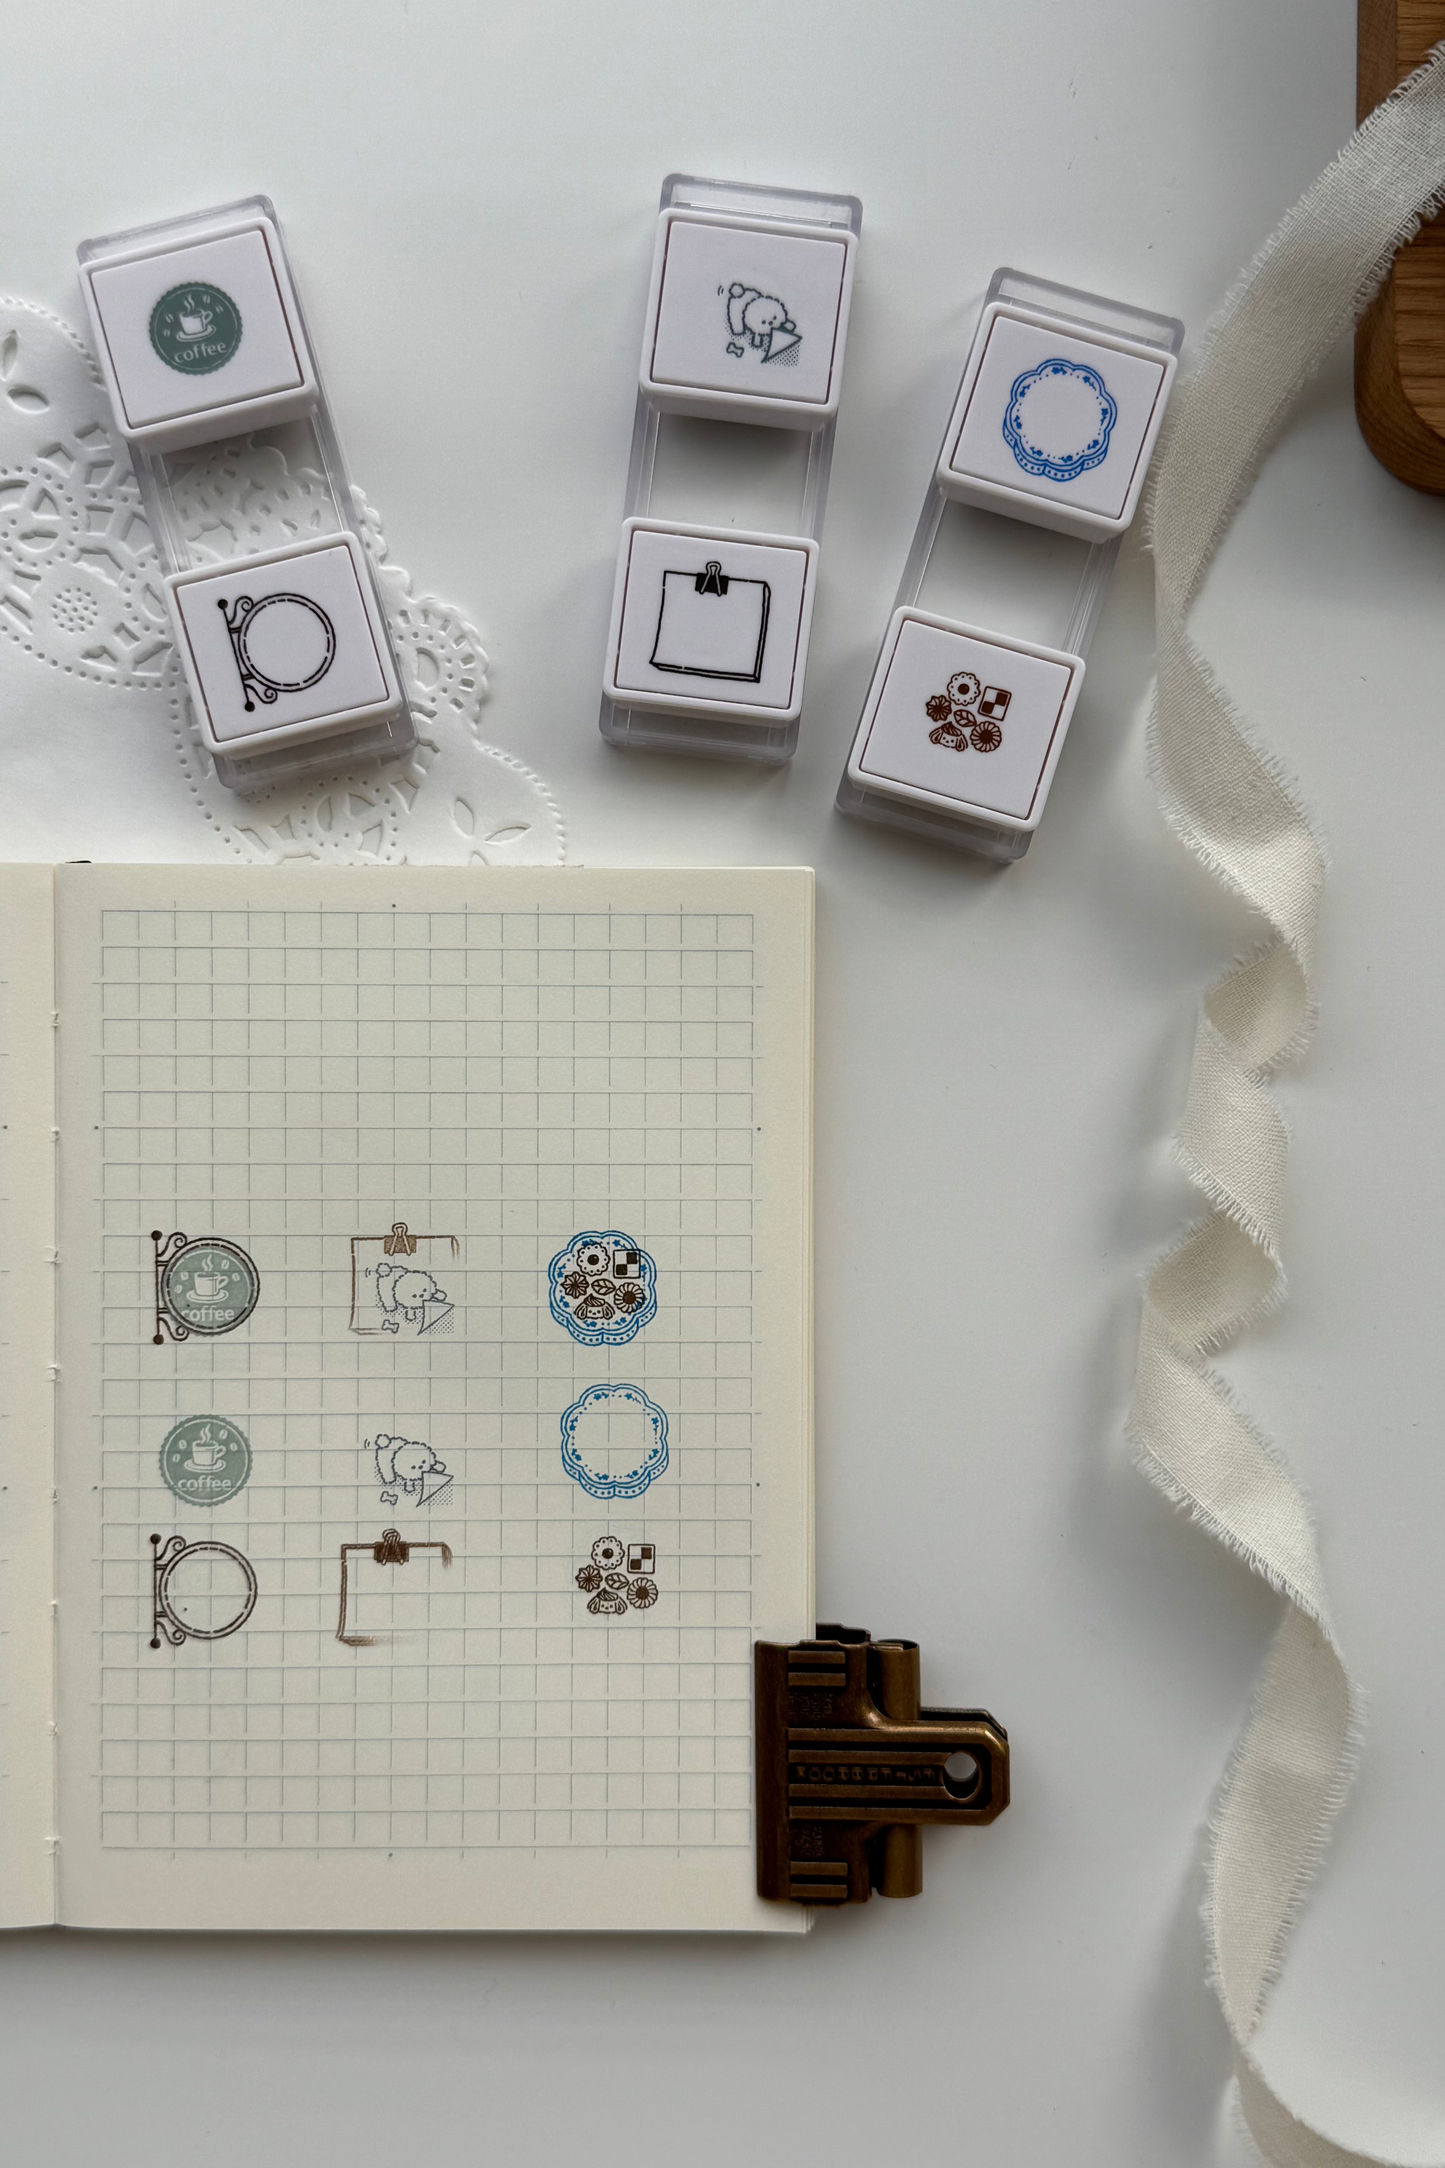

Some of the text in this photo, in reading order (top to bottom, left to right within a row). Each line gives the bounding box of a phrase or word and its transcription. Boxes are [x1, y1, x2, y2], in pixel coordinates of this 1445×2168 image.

[174, 342, 227, 363] coffee
[181, 1305, 235, 1321] coffee
[177, 1475, 232, 1491] coffee
